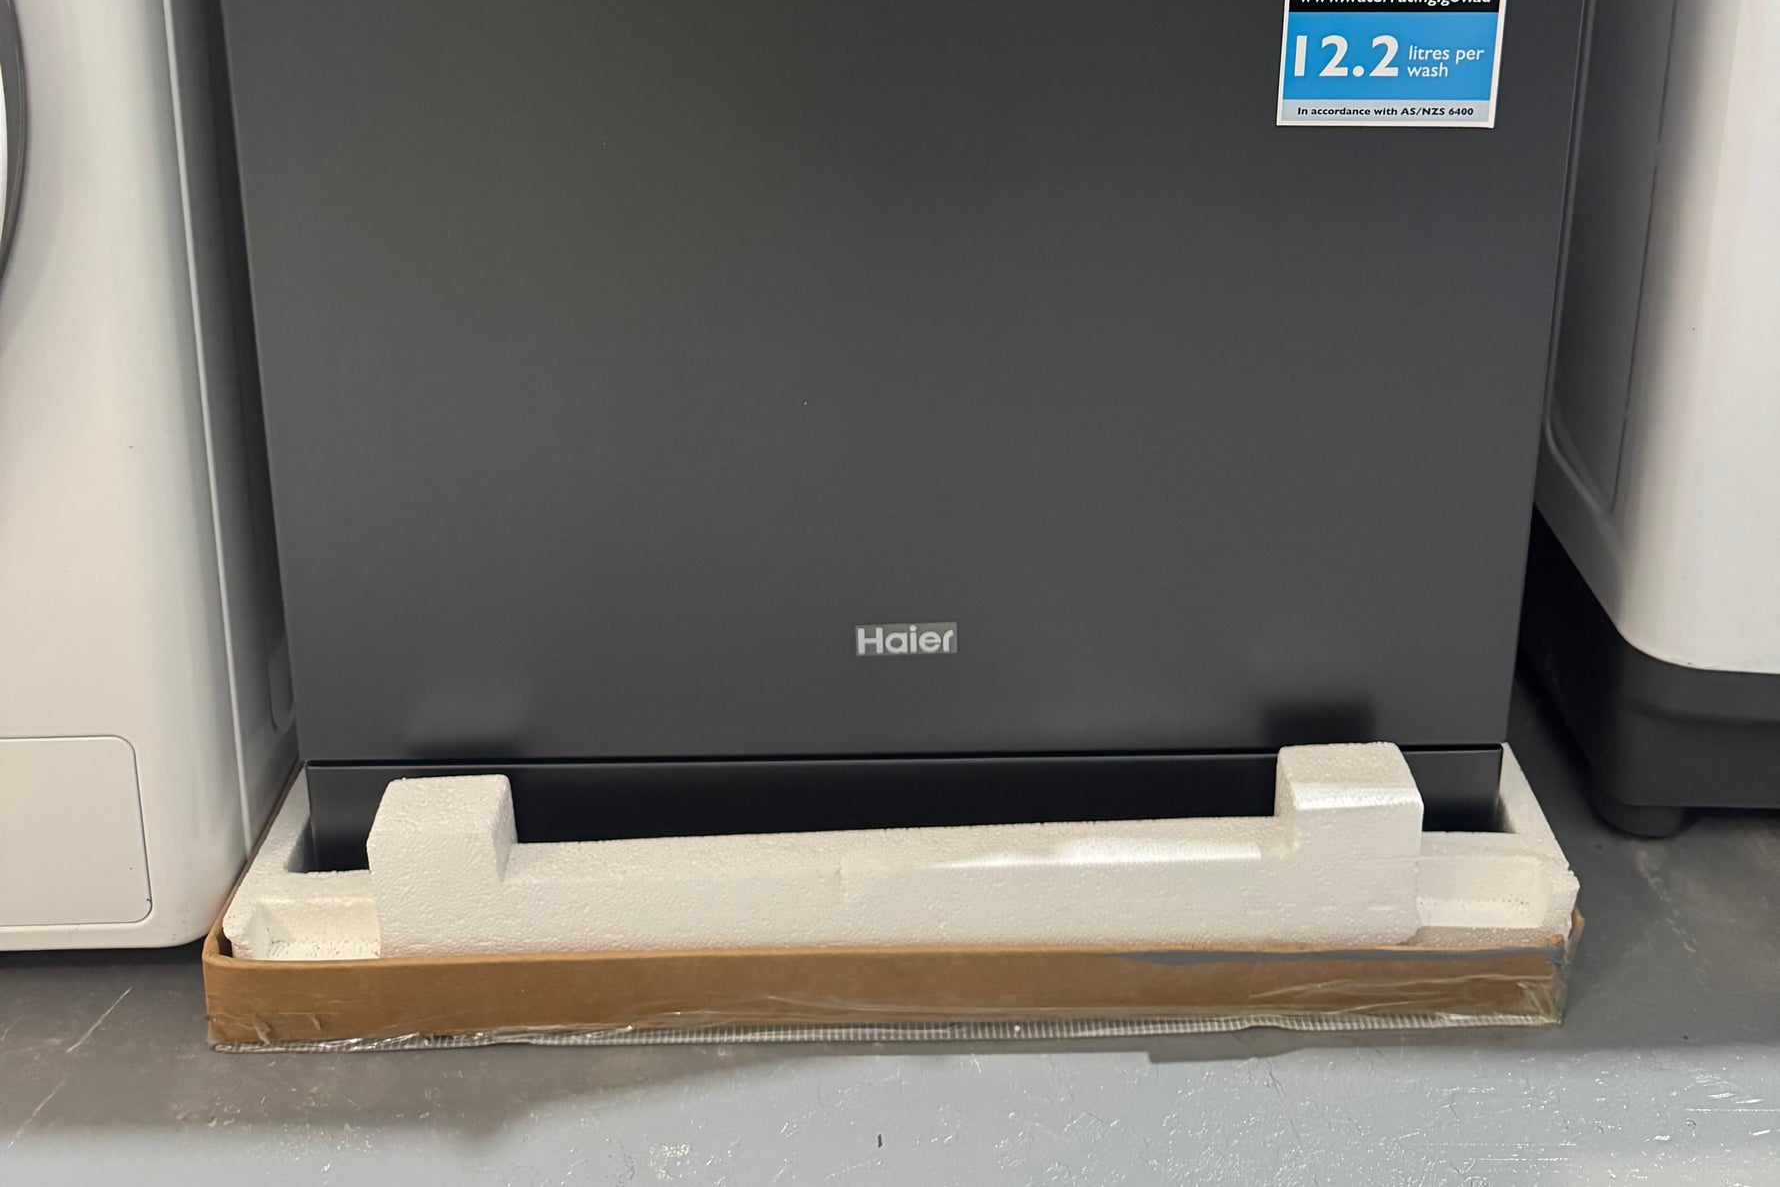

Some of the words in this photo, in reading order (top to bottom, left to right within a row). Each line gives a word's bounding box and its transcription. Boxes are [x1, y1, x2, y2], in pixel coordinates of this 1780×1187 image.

[1293, 35, 1399, 77] 12.2
[1408, 45, 1450, 61] litres
[1455, 48, 1484, 65] per
[1407, 62, 1448, 77] wash
[1297, 107, 1308, 116] In
[1310, 106, 1371, 116] accordance
[1373, 106, 1398, 116] with
[1400, 107, 1446, 116] AS/NZS
[1448, 107, 1474, 116] 6400
[857, 624, 954, 654] Haier
